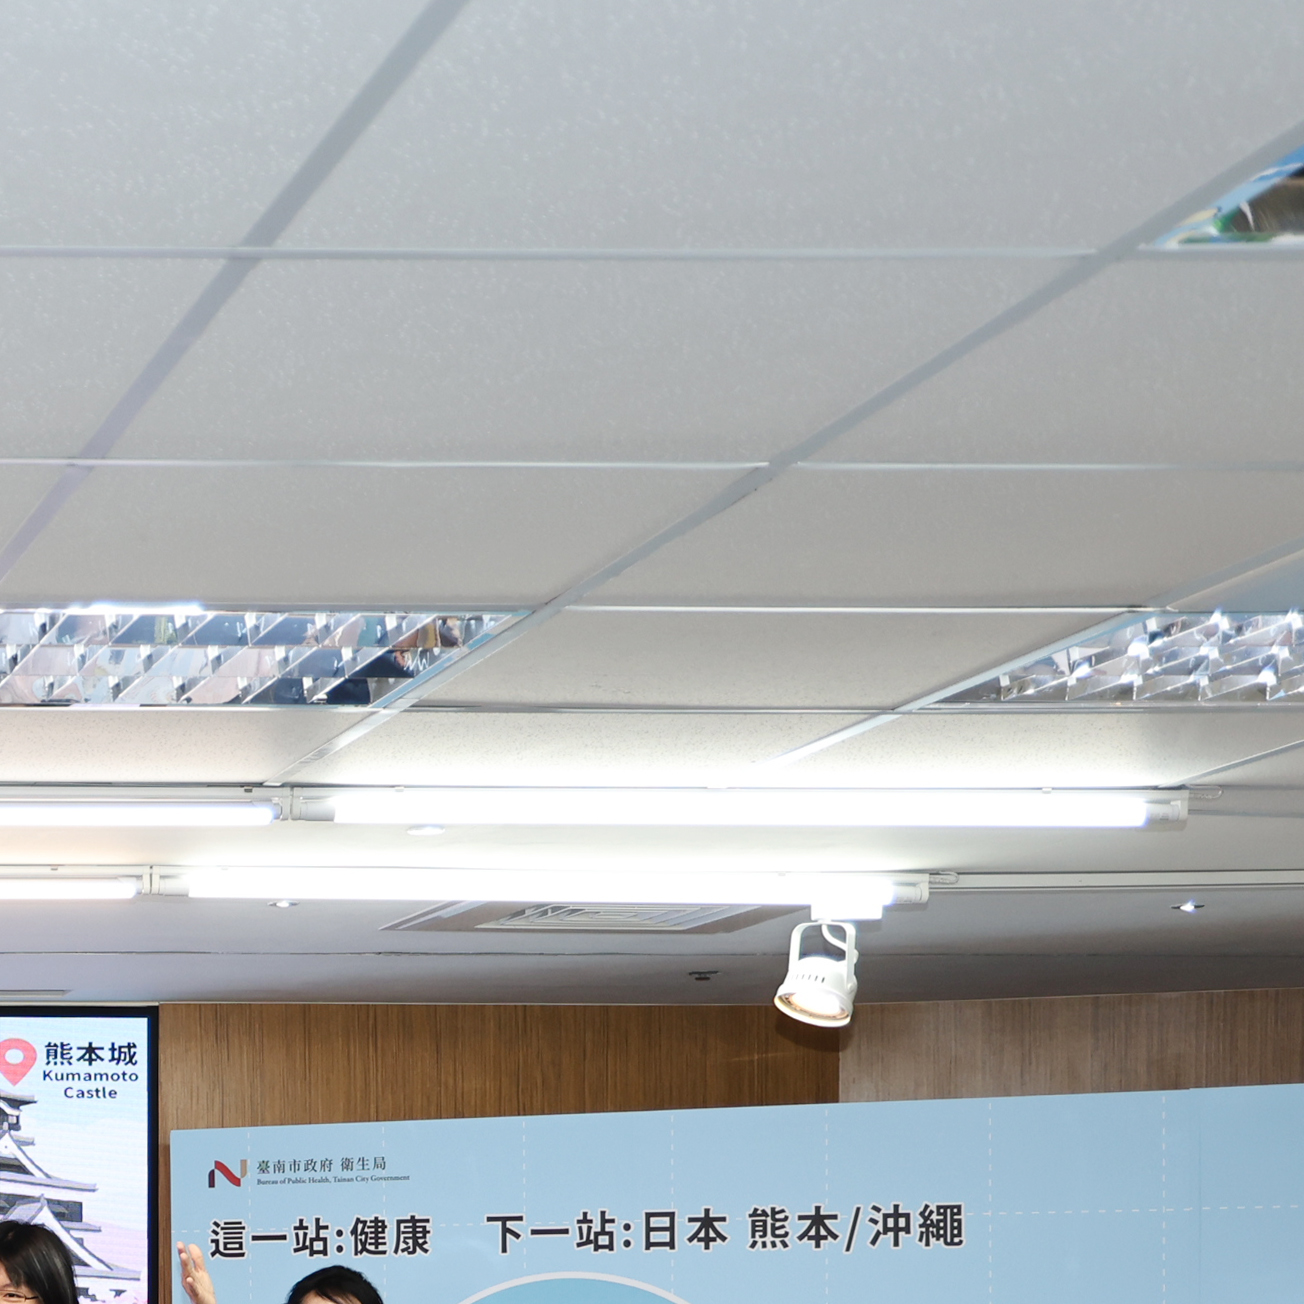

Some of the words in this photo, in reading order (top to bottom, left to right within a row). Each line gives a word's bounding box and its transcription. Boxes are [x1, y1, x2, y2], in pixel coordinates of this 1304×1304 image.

[45, 1041, 138, 1066] 熊本城
[43, 1070, 139, 1082] Kumamoto
[64, 1086, 118, 1099] Castle
[257, 1158, 333, 1174] 臺南市政府
[341, 1156, 386, 1172] 衛生局
[287, 1176, 307, 1184] Public
[309, 1176, 332, 1184] Health,
[333, 1175, 354, 1183] Tainan
[356, 1175, 369, 1184] City
[370, 1174, 410, 1183] Government
